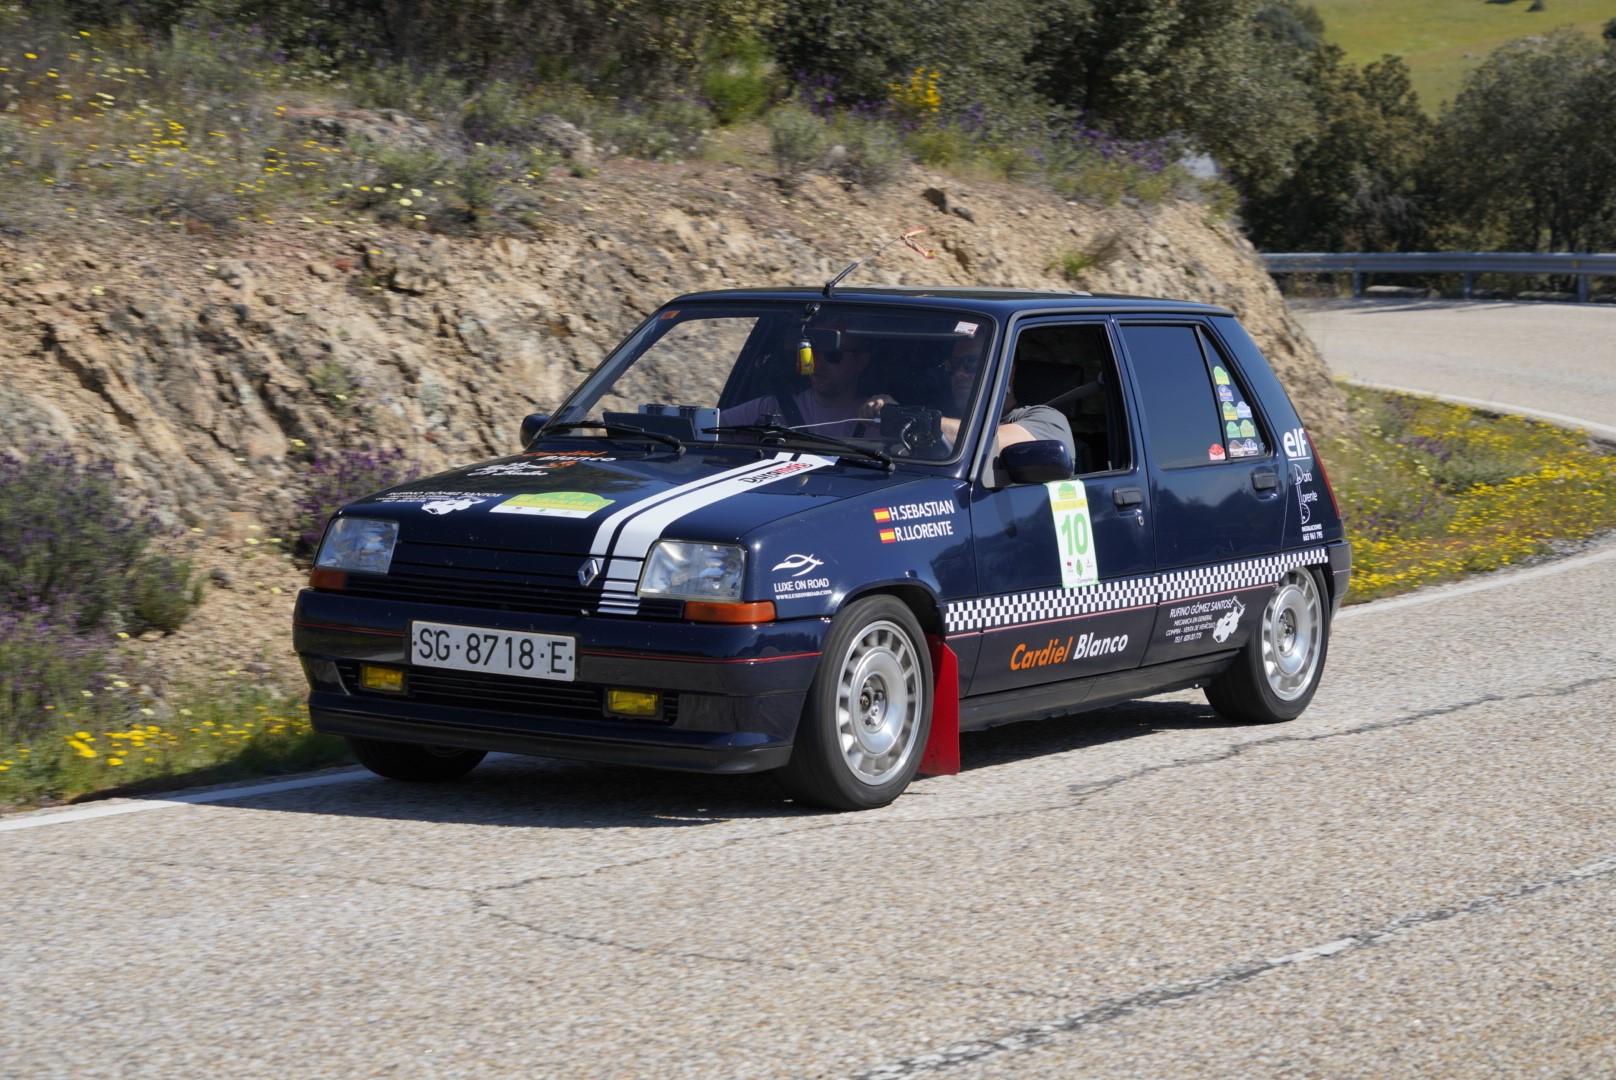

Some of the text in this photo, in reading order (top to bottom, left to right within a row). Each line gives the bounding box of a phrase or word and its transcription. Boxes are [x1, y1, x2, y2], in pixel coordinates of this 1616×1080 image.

[1283, 428, 1307, 458] elf
[888, 500, 955, 522] H.SEBASTIAN
[895, 521, 954, 542] R.LLORENTE
[1061, 512, 1089, 557] 10
[773, 577, 830, 593] LUXE ON ROAD
[1169, 606, 1190, 618] RUFINO
[1190, 602, 1211, 615] GÓMEZ
[1010, 632, 1129, 671] Cardiel Blanco
